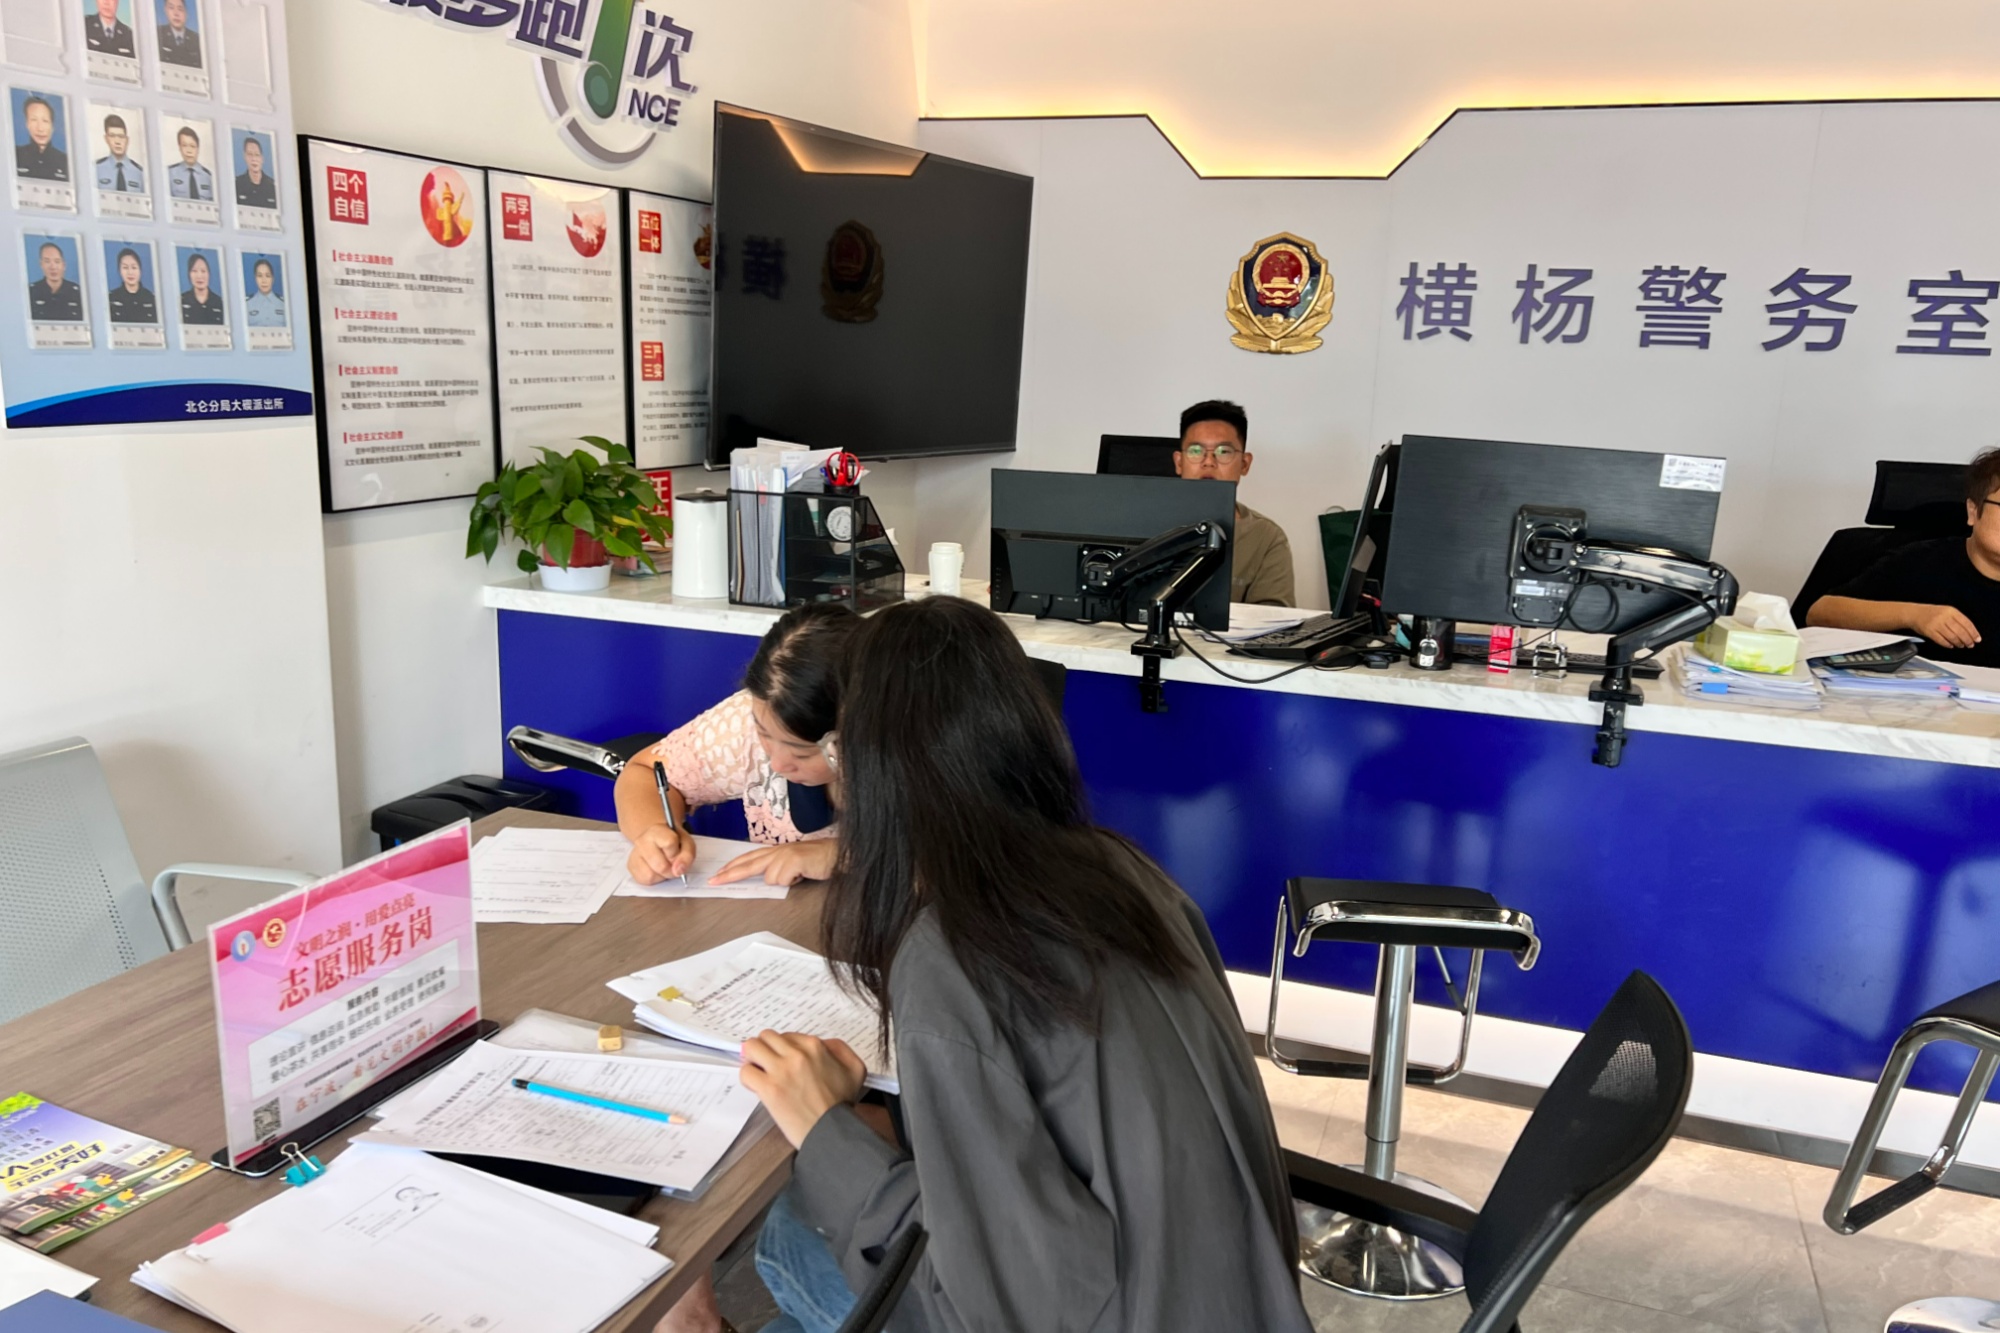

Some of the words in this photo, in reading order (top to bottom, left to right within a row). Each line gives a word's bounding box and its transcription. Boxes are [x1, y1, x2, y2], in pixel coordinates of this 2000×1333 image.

[628, 88, 682, 126] NCE
[332, 171, 364, 195] 四个
[334, 197, 366, 220] 自信
[505, 196, 529, 215] 两学
[506, 219, 530, 236] 一做
[641, 213, 660, 231] 五位
[641, 234, 660, 250] 一体
[1396, 261, 1999, 357] 横杨警务室
[643, 344, 662, 359] 三严
[644, 363, 663, 378] 三实
[276, 903, 433, 1015] 志愿服务岗
